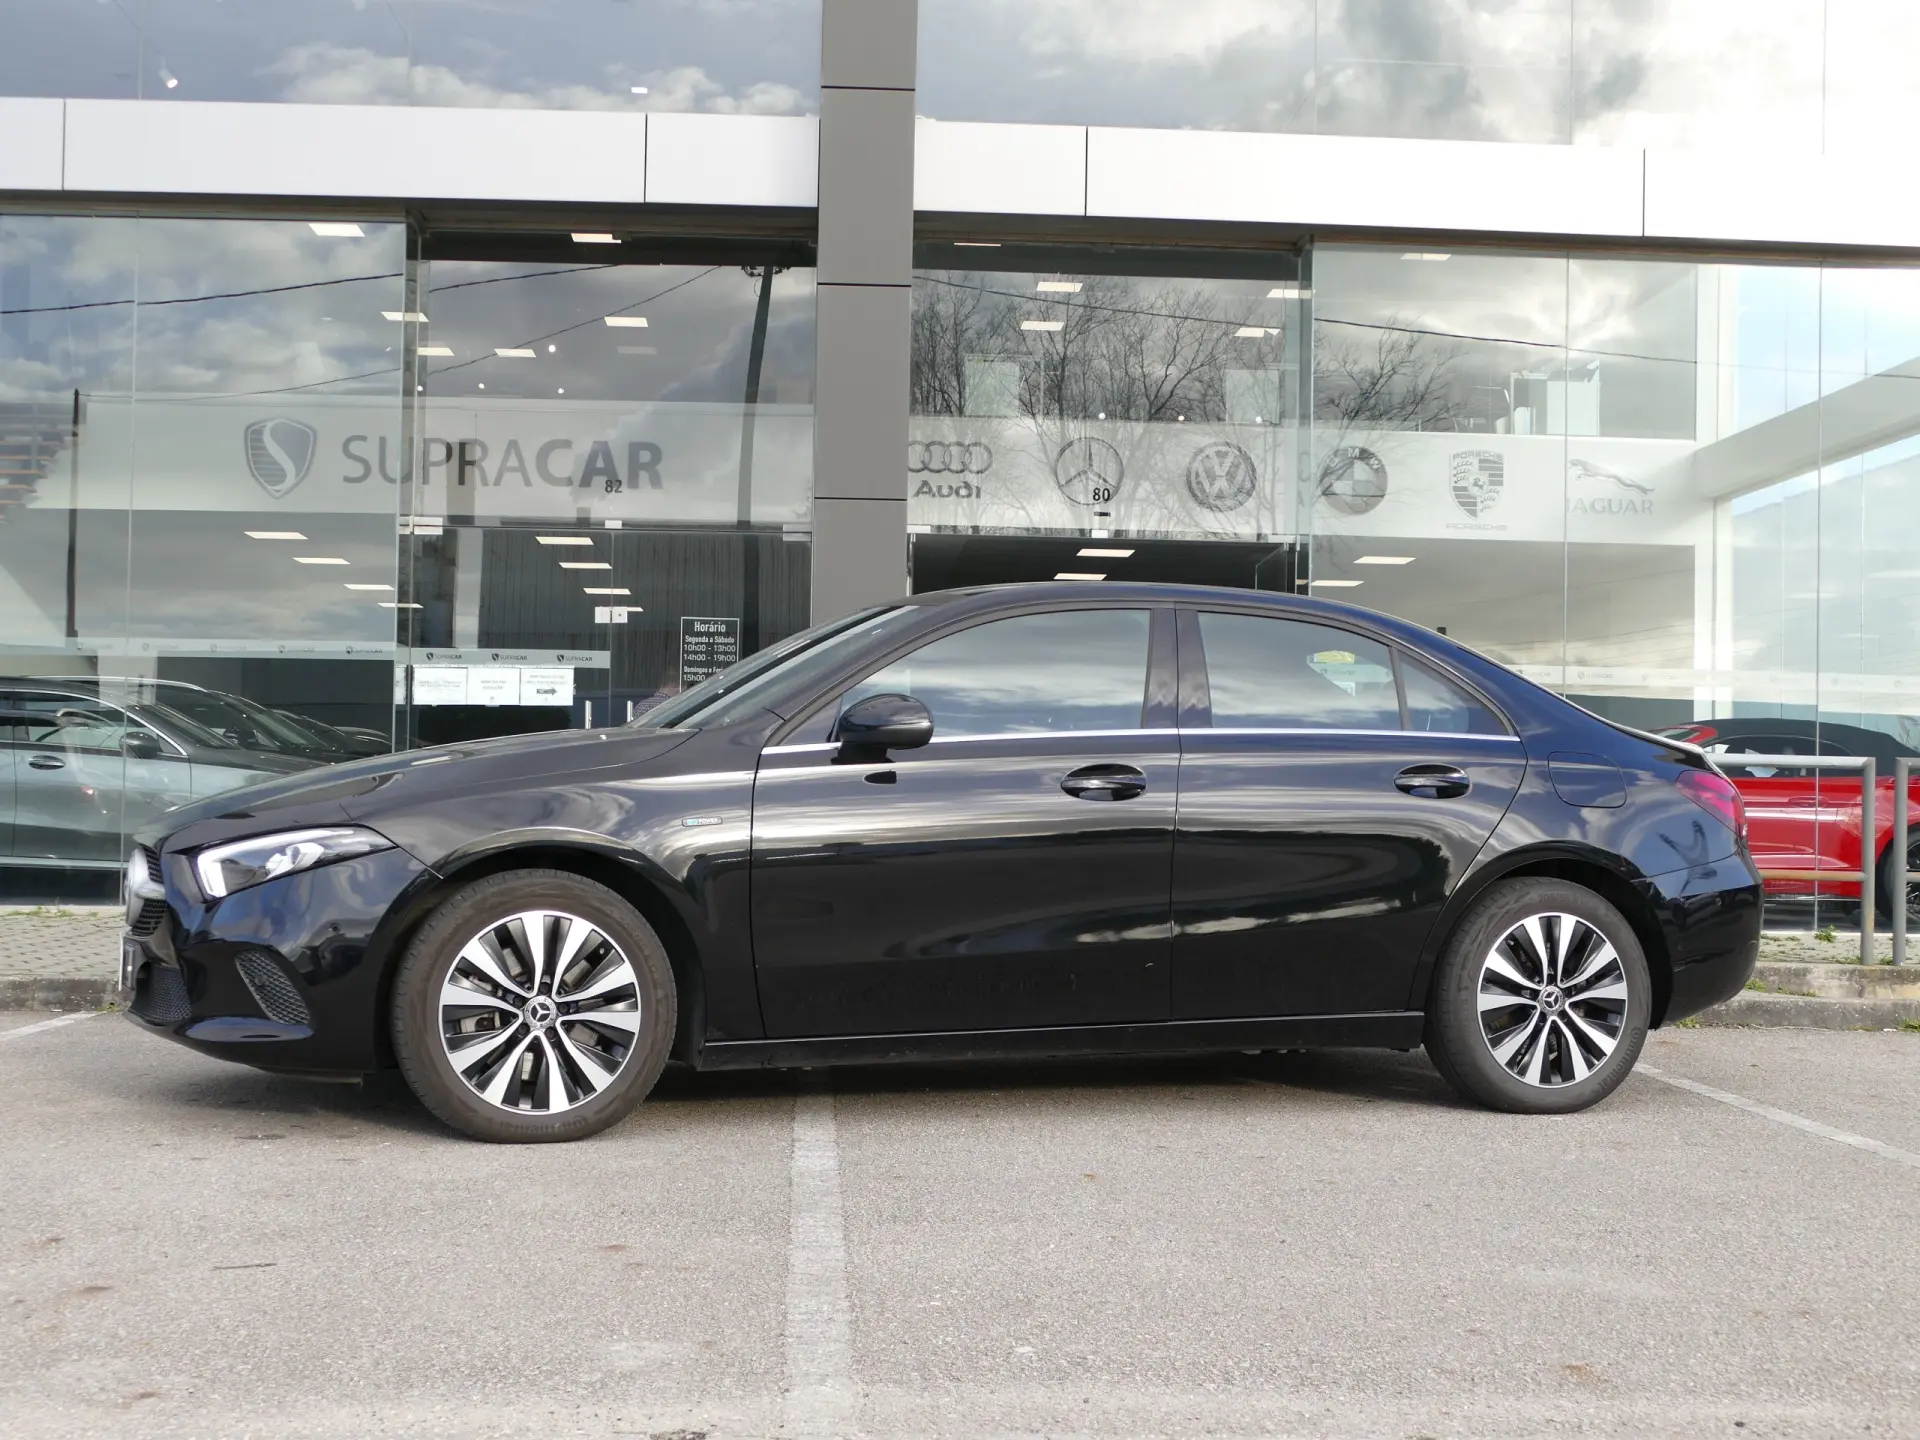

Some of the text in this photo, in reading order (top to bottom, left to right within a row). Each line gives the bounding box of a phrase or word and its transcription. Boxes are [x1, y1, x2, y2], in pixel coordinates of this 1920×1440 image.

[342, 434, 664, 491] SUPRACAR
[605, 479, 623, 494] 82
[912, 479, 982, 500] Audi
[1092, 486, 1111, 502] 80
[694, 621, 726, 632] Horário
[685, 635, 708, 644] Segunda
[684, 666, 708, 674] Domingos
